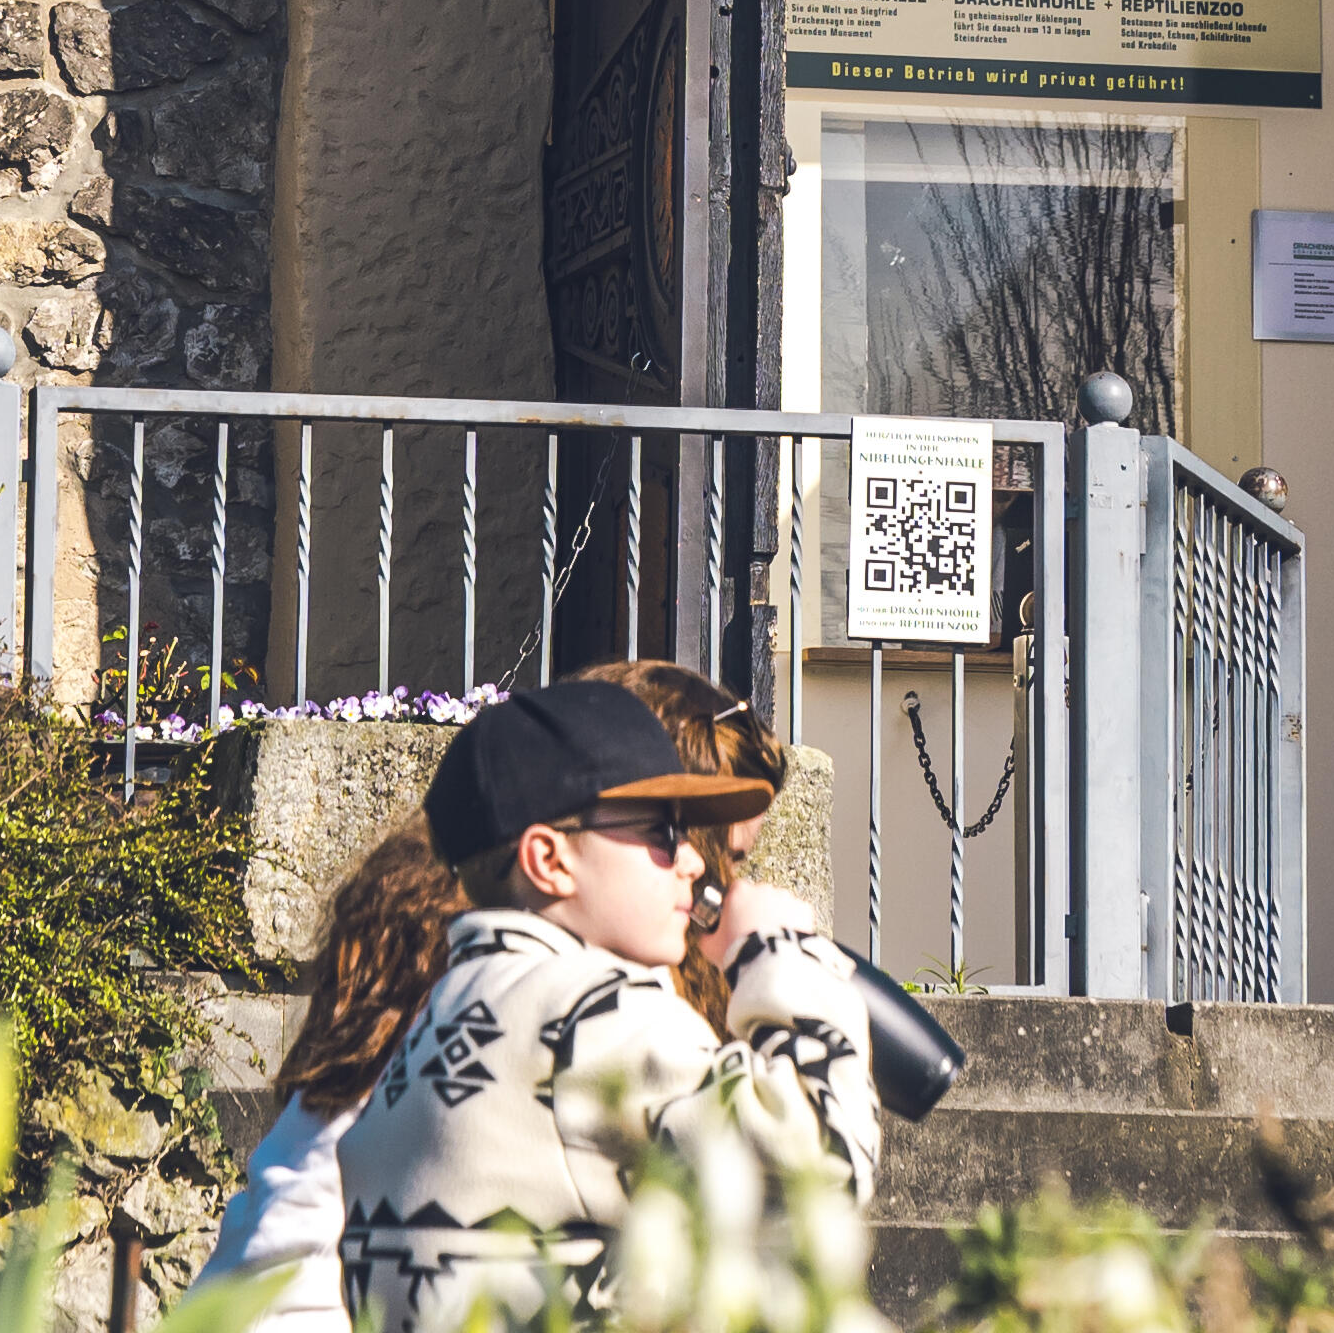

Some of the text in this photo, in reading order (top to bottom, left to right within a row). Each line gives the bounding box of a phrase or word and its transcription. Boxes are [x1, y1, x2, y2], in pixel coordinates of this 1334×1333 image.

[791, 4, 804, 12] Sie
[807, 4, 819, 14] die
[822, 5, 841, 14] Welt
[861, 6, 898, 17] Siegfried
[792, 15, 881, 27] Drachensage in einem
[954, 10, 1082, 26] Ein geheimnisvoller Höhlengang
[1121, 17, 1163, 28] Bestaunen
[1166, 19, 1178, 28] Sie
[787, 27, 873, 38] uckenden Monument
[954, 22, 974, 31] führt
[977, 23, 990, 32] Sie
[993, 23, 1021, 33] danach
[1042, 25, 1052, 34] 13
[1064, 27, 1091, 37] langen
[954, 33, 1008, 44] Steindrachen
[1201, 32, 1252, 43] Schildkröten
[1121, 41, 1177, 51] und Krokodile
[831, 61, 1184, 90] Dieser Betrieb wird privat geführt!
[859, 452, 985, 468] NIBELUNGENHALLE
